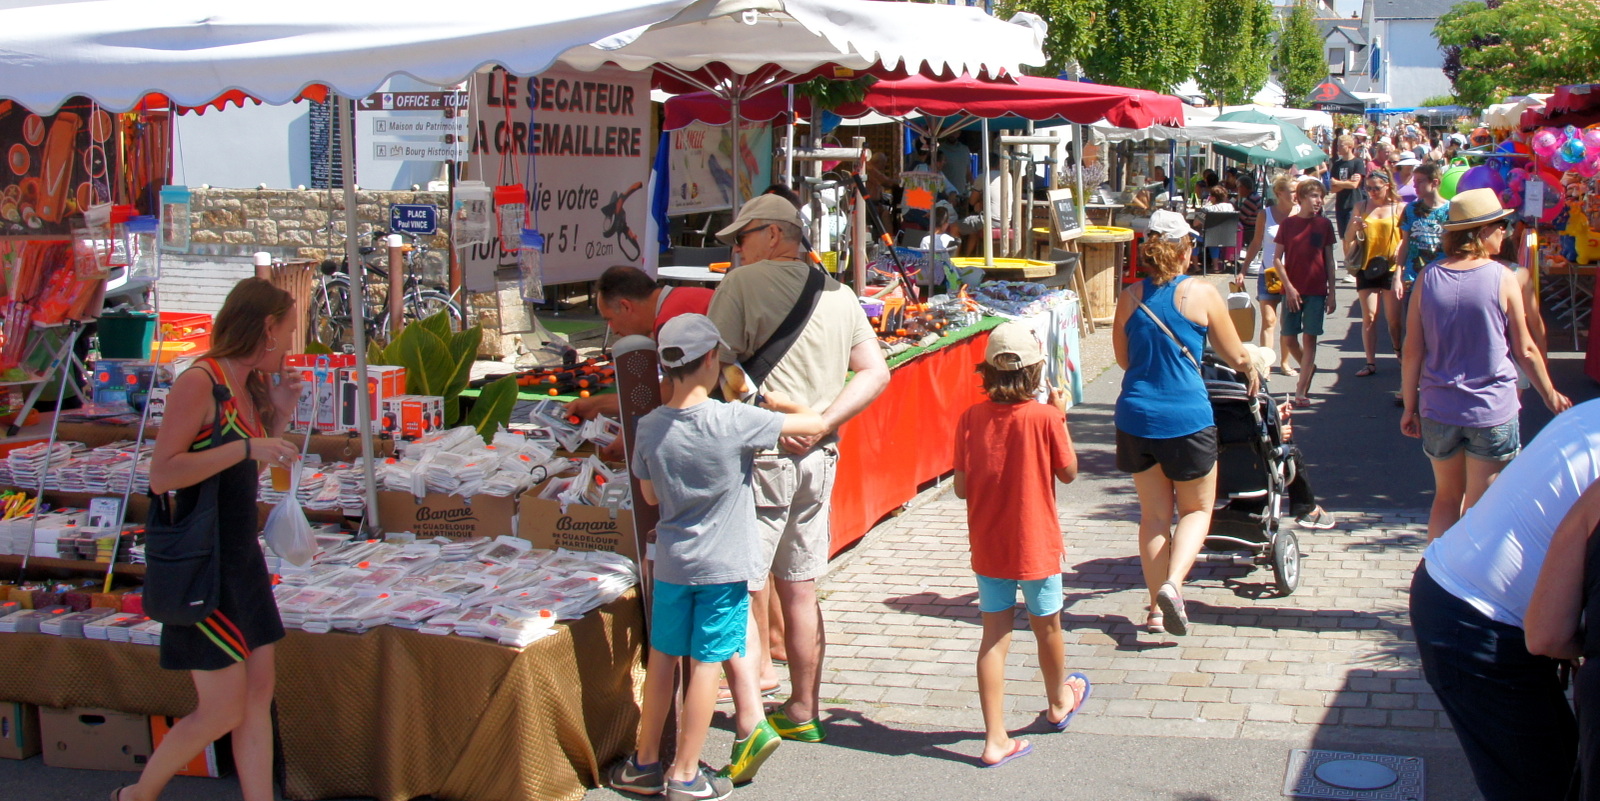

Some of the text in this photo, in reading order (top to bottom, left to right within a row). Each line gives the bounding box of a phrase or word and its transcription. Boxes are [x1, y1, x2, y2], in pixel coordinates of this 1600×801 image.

[486, 73, 635, 116] LE SECATEUR
[396, 95, 430, 107] OFFICE
[431, 98, 441, 107] DE
[389, 121, 413, 131] Maison
[415, 121, 424, 131] du
[472, 120, 490, 155] A
[494, 120, 642, 157] CREMAILLERE
[405, 147, 426, 158] Bourg
[557, 186, 599, 212] votre
[407, 210, 427, 219] PLACE
[397, 220, 428, 229] Paul VINCE
[558, 225, 569, 253] 5
[573, 224, 579, 252] !
[596, 242, 614, 258] 2cm
[416, 506, 480, 522] Banane
[556, 516, 624, 537] Banane
[422, 530, 473, 538] MARTINIQUE
[561, 533, 619, 545] GUADELOUPE
[561, 540, 616, 551] MARTINIQUE
